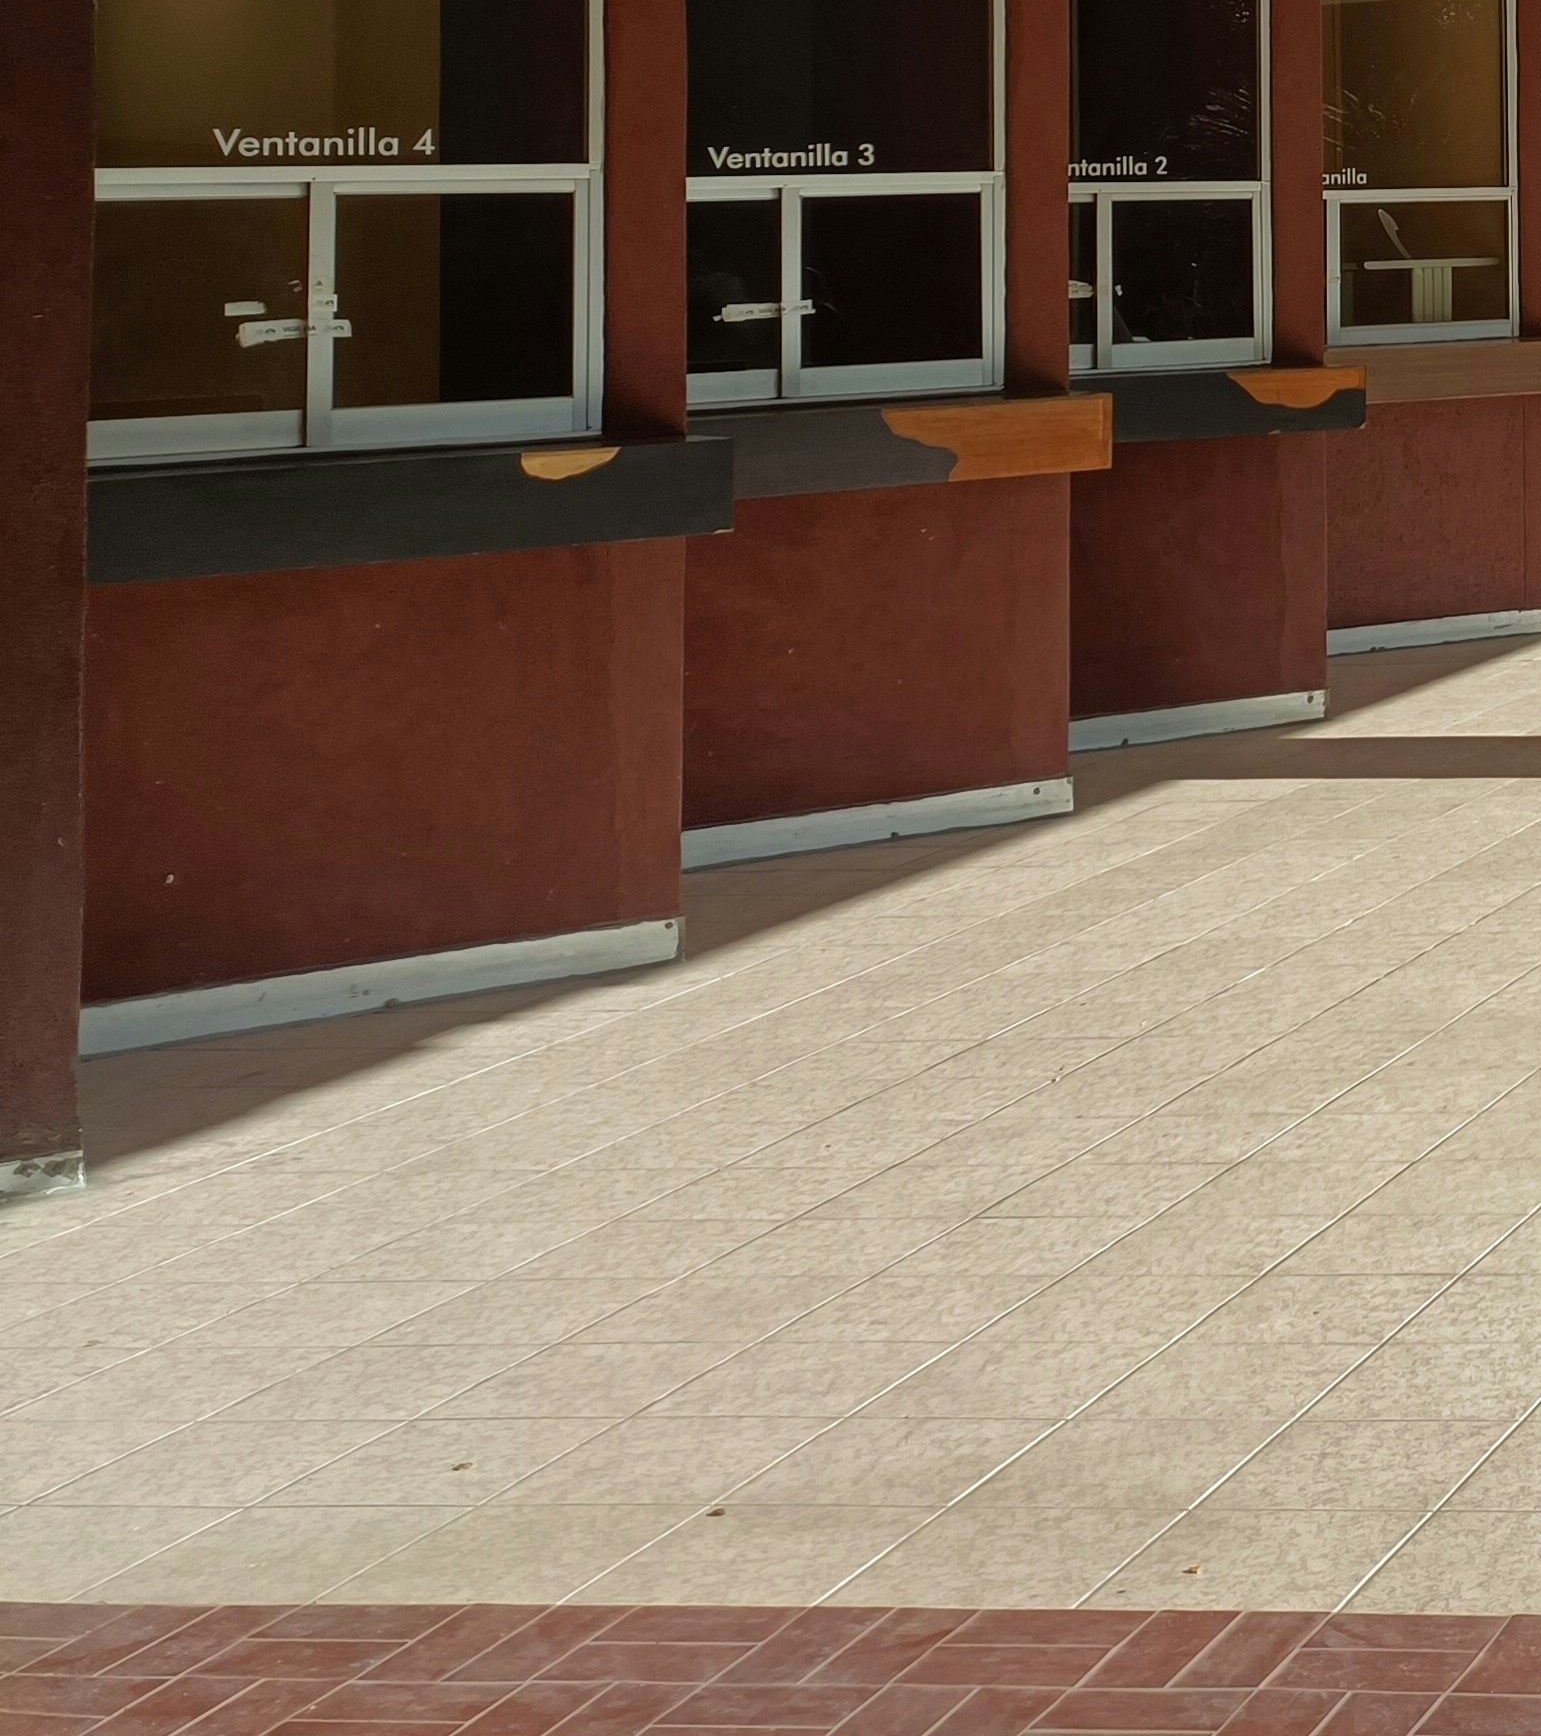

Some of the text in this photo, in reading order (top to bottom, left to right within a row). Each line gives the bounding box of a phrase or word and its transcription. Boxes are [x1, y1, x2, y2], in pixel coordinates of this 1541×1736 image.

[212, 127, 436, 157] Ventanilla 4
[707, 143, 875, 170] Ventanilla 3
[1068, 156, 1168, 177] ntanilla 2
[1322, 168, 1367, 186] anilla
